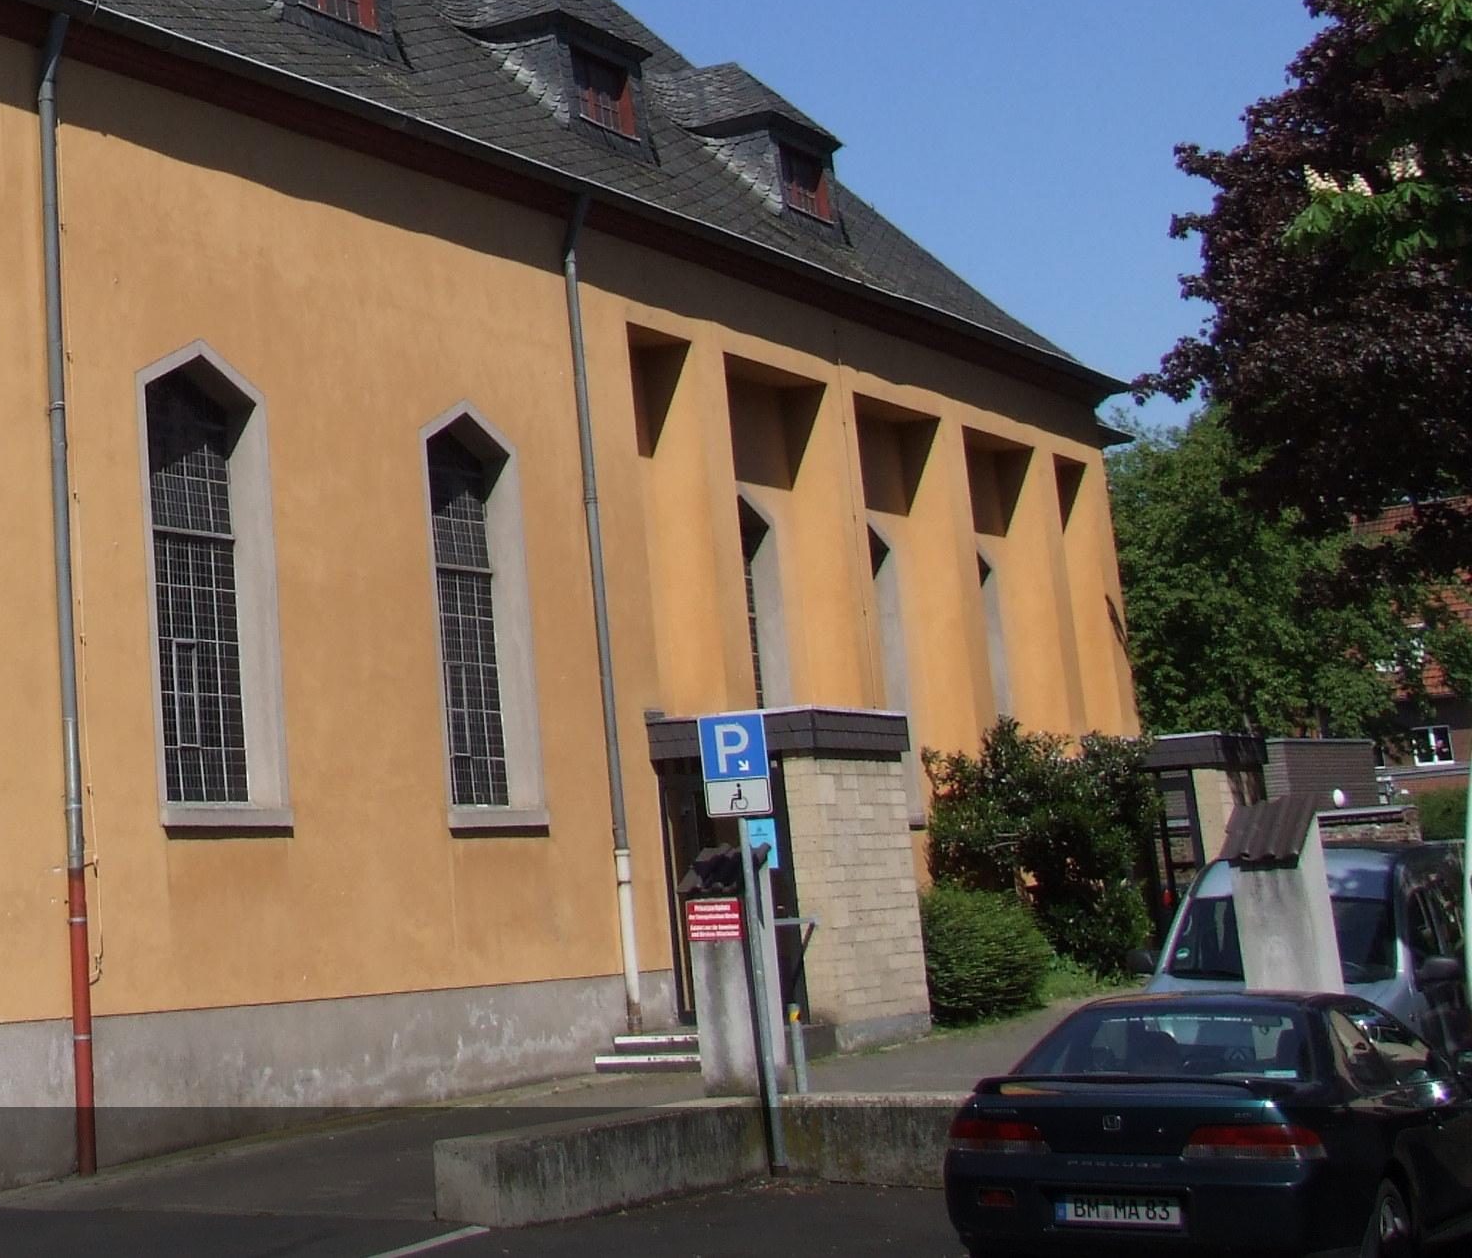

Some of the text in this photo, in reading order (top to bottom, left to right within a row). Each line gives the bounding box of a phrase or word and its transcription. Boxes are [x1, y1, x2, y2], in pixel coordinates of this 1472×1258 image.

[714, 723, 749, 774] P
[1073, 1198, 1100, 1218] BM
[1113, 1198, 1140, 1220] MA
